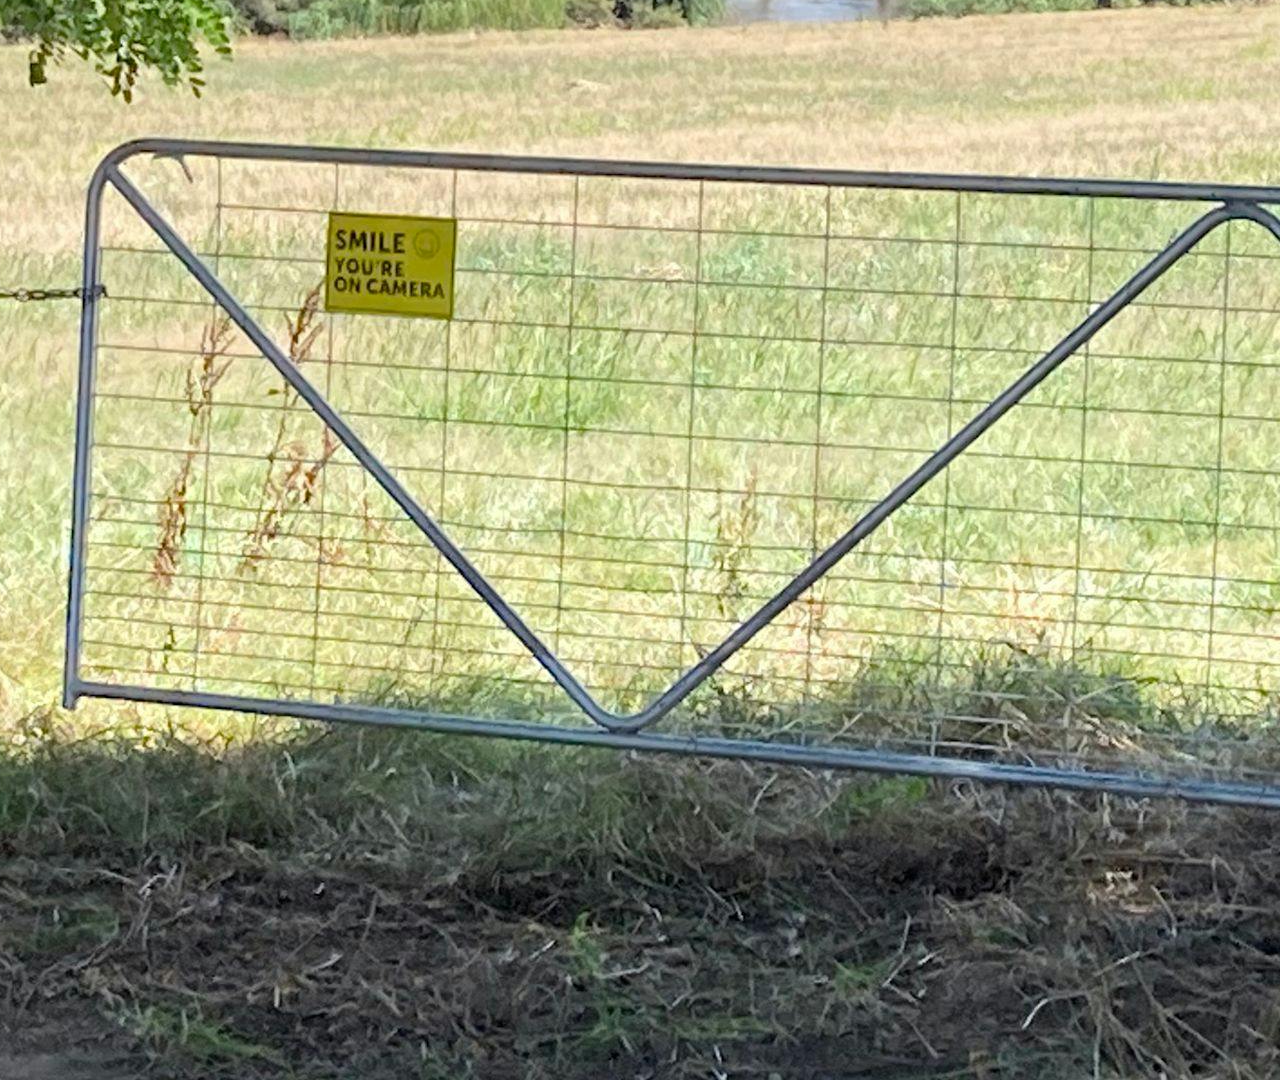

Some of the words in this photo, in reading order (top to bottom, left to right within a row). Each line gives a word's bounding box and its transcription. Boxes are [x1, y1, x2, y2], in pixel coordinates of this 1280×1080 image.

[335, 229, 406, 254] SMILE
[335, 257, 405, 277] YOU'RE
[334, 276, 361, 294] ON
[366, 278, 445, 299] CAMERA
